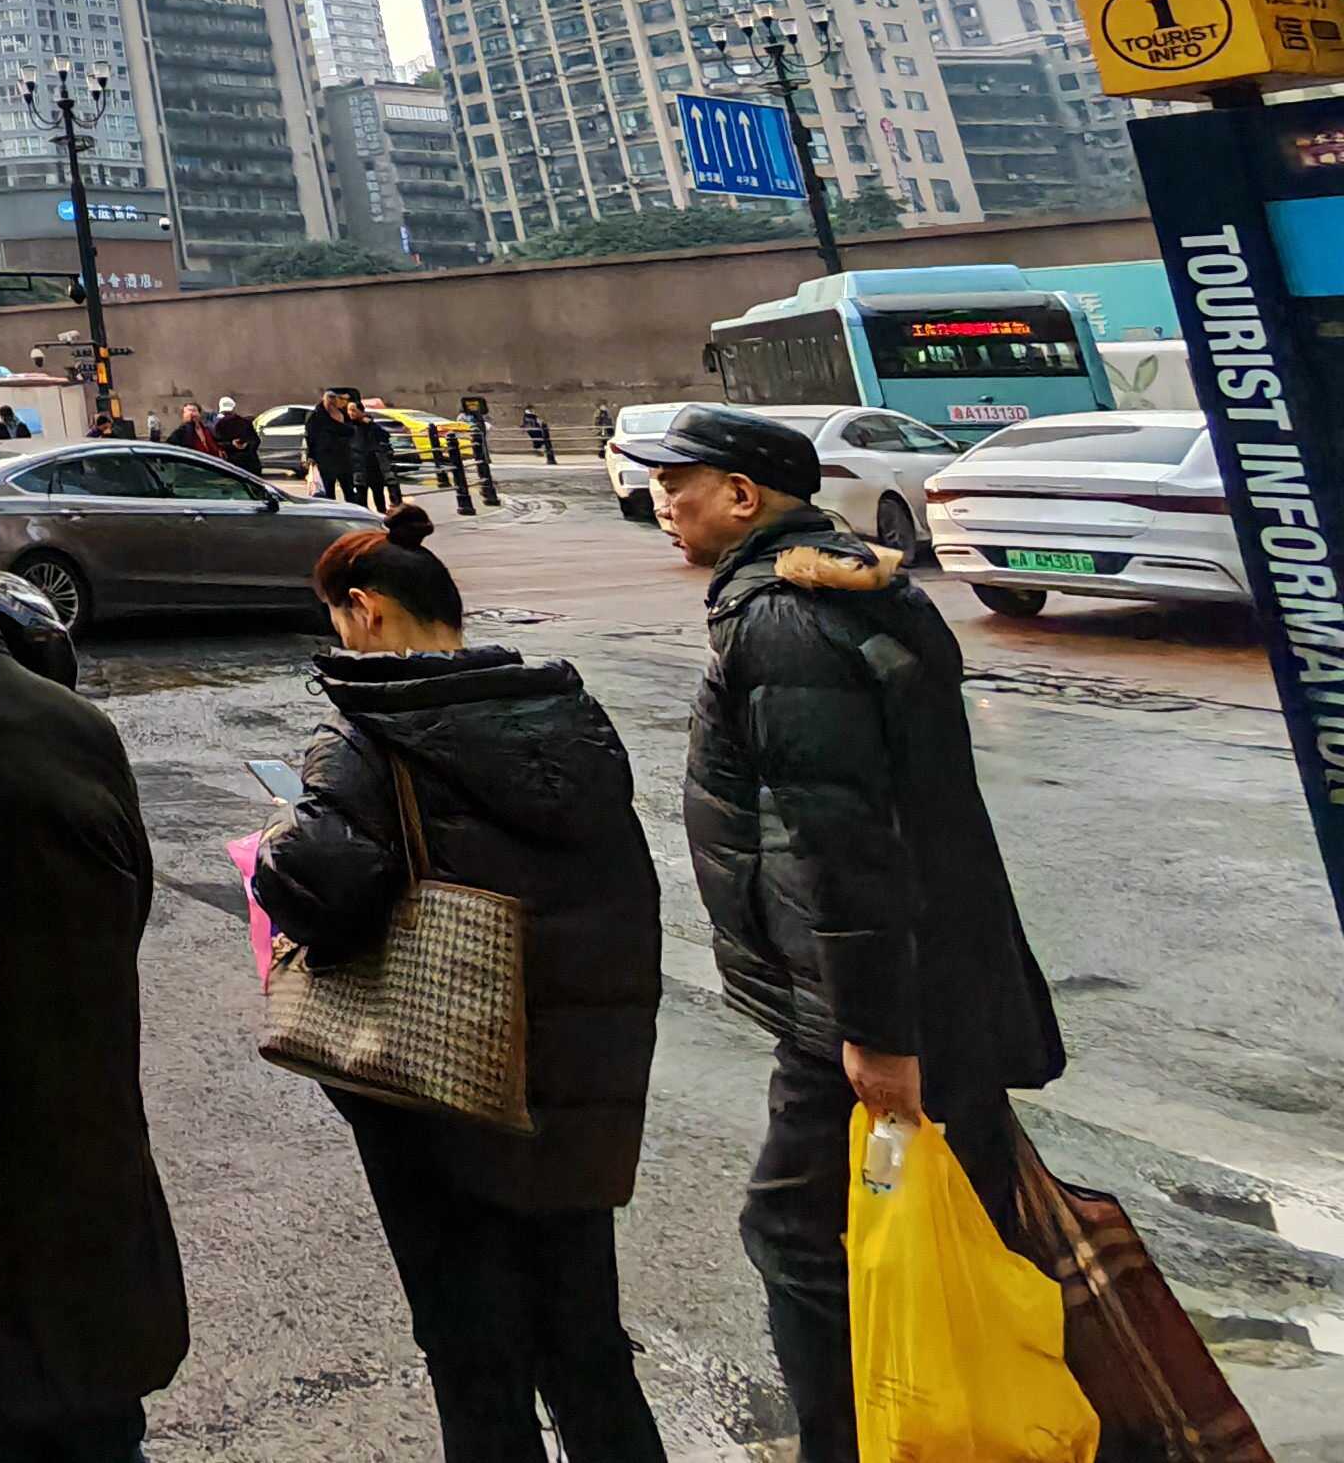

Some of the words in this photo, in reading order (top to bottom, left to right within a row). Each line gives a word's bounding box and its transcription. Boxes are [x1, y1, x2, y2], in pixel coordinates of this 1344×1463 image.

[1122, 24, 1224, 53] TOURIST
[1148, 43, 1202, 64] INFO
[1180, 224, 1295, 432] TOURIST
